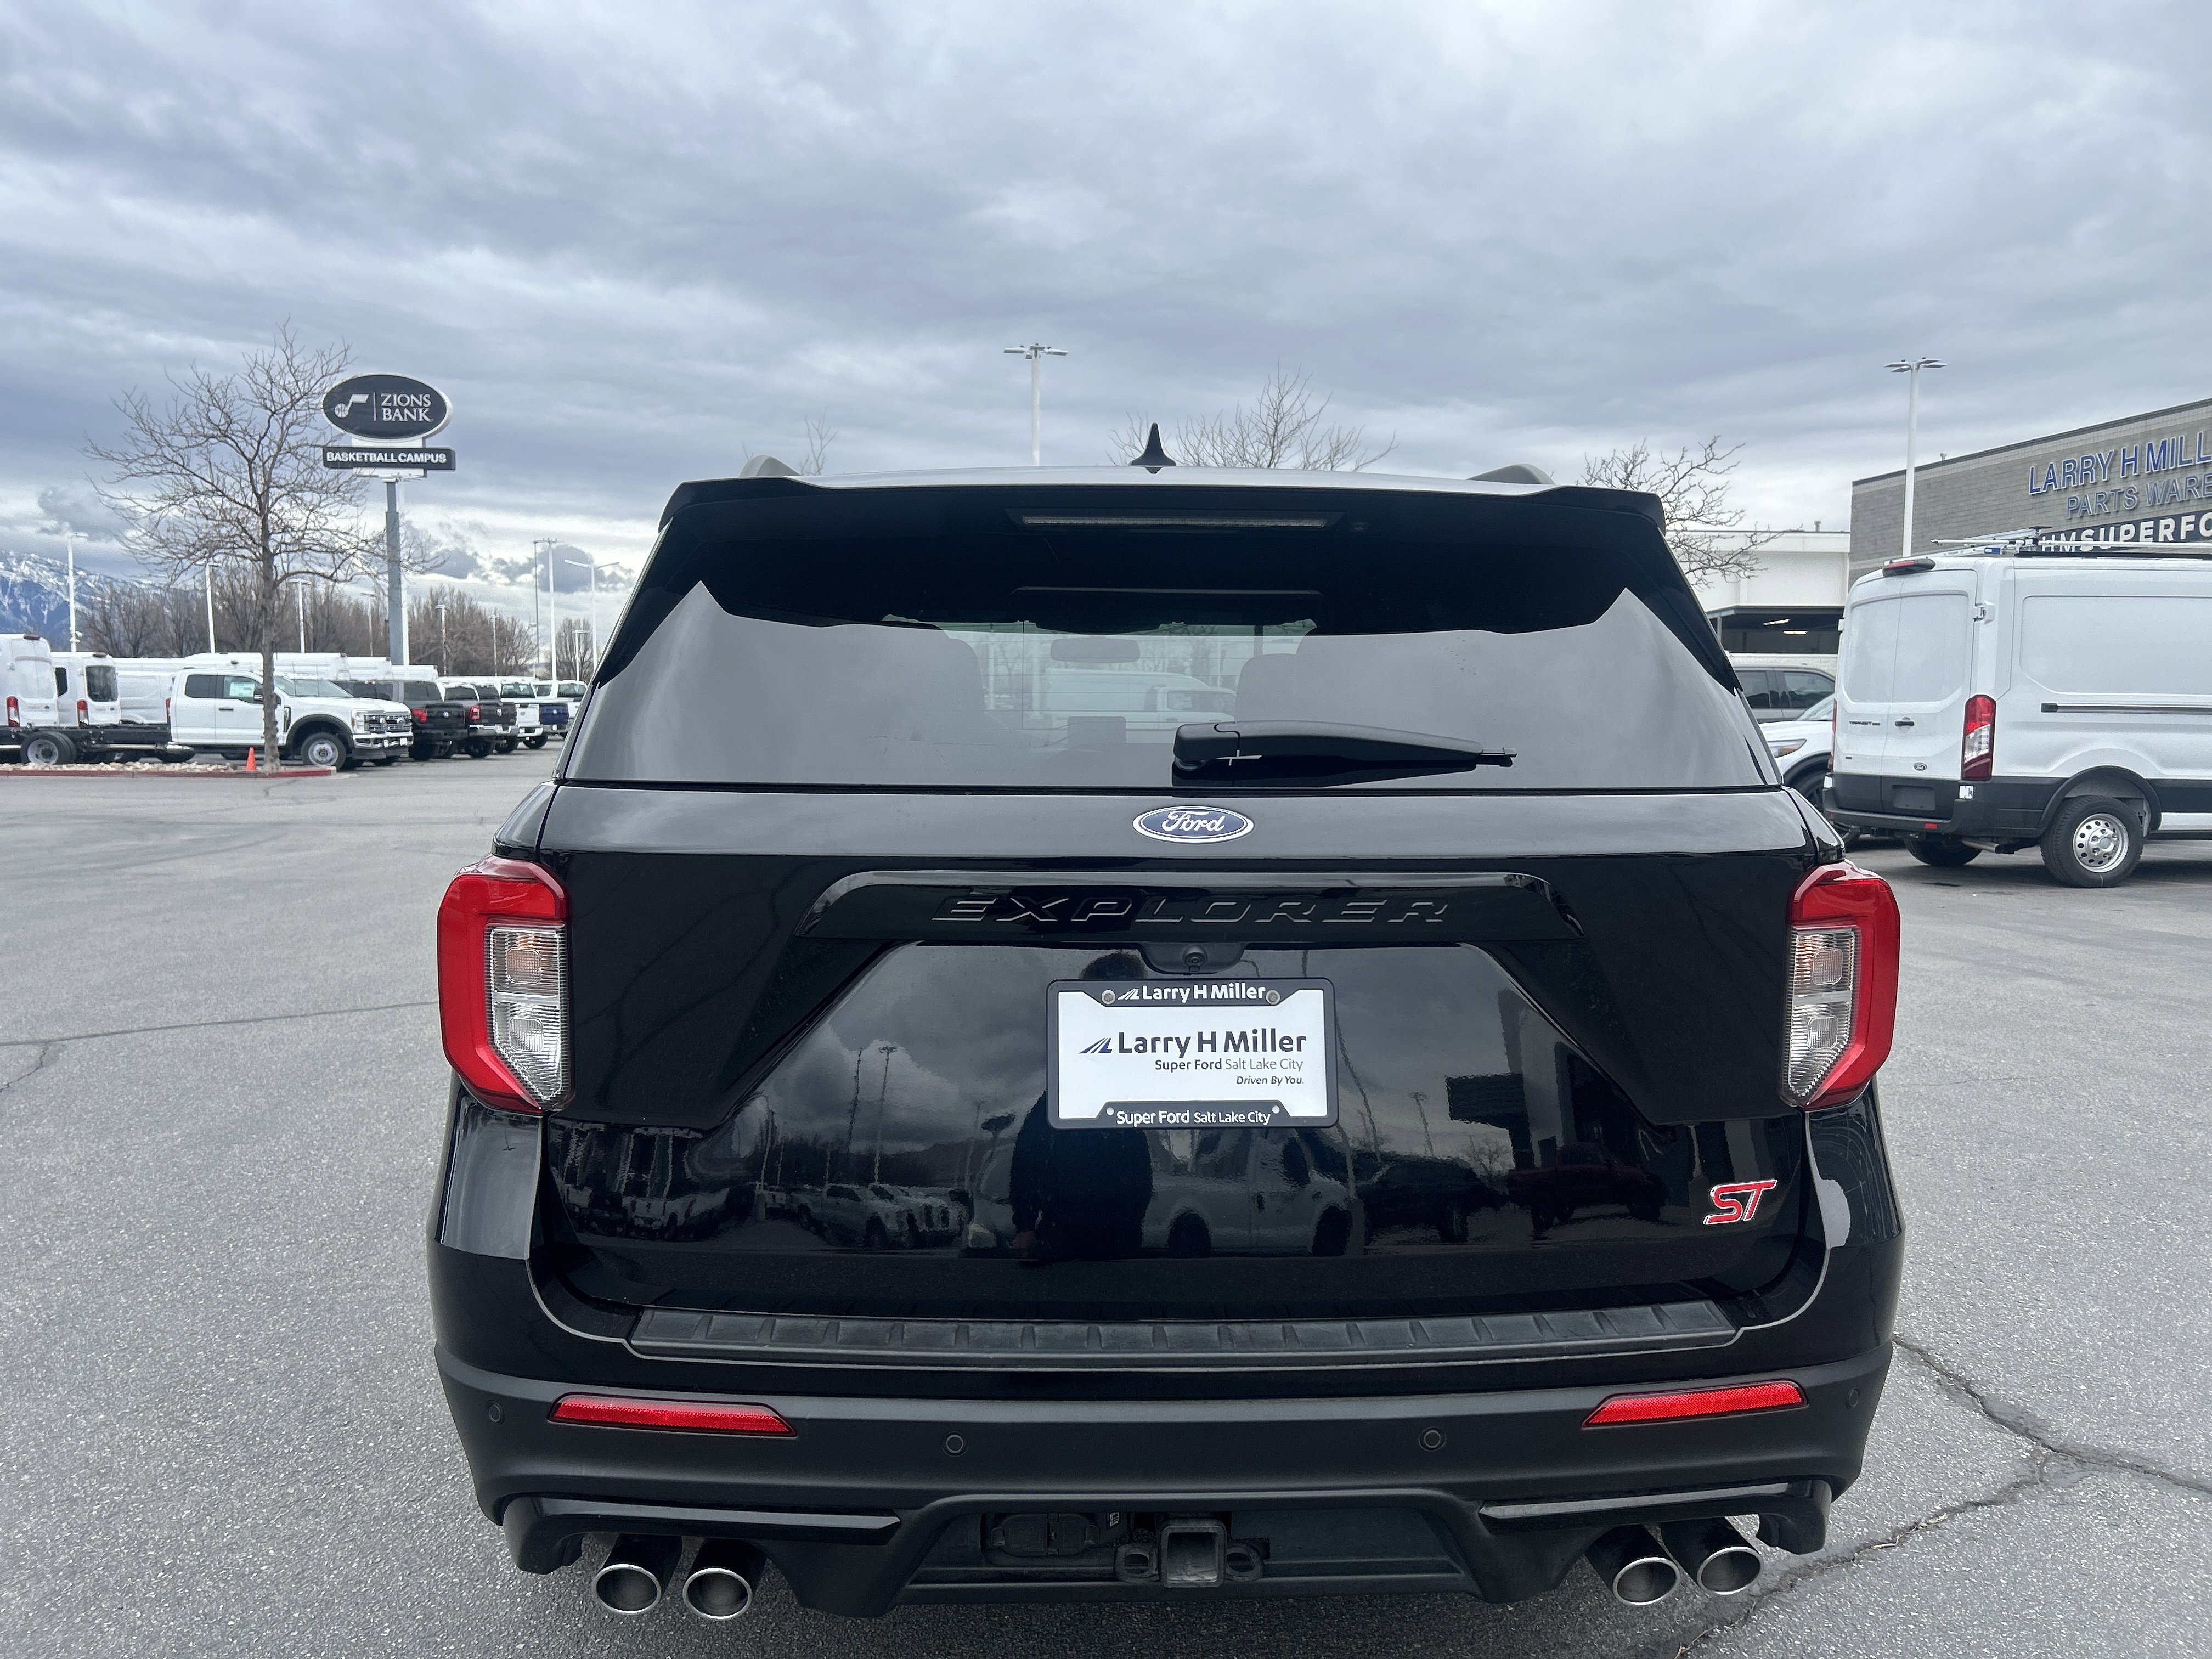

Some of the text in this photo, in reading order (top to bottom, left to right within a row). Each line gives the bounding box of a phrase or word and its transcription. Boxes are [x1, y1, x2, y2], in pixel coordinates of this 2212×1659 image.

[381, 393, 431, 407] ZIONS
[381, 408, 432, 422] BANK
[326, 452, 447, 464] BASKETBALL CAMPUS
[2028, 431, 2212, 495] LARRY H MILL
[2067, 484, 2138, 519] PARTS
[1161, 810, 1226, 832] Ford
[930, 896, 1448, 923] EXPLORER
[1142, 983, 1266, 1003] Larry H Miller
[1118, 1028, 1307, 1058] Larry H Miller
[1155, 1058, 1304, 1073] Super Ford Salt Lake City
[1236, 1075, 1304, 1086] Driven By You.
[1116, 1110, 1271, 1127] Super Ford Salt Lake City
[1703, 1179, 1778, 1225] ST
